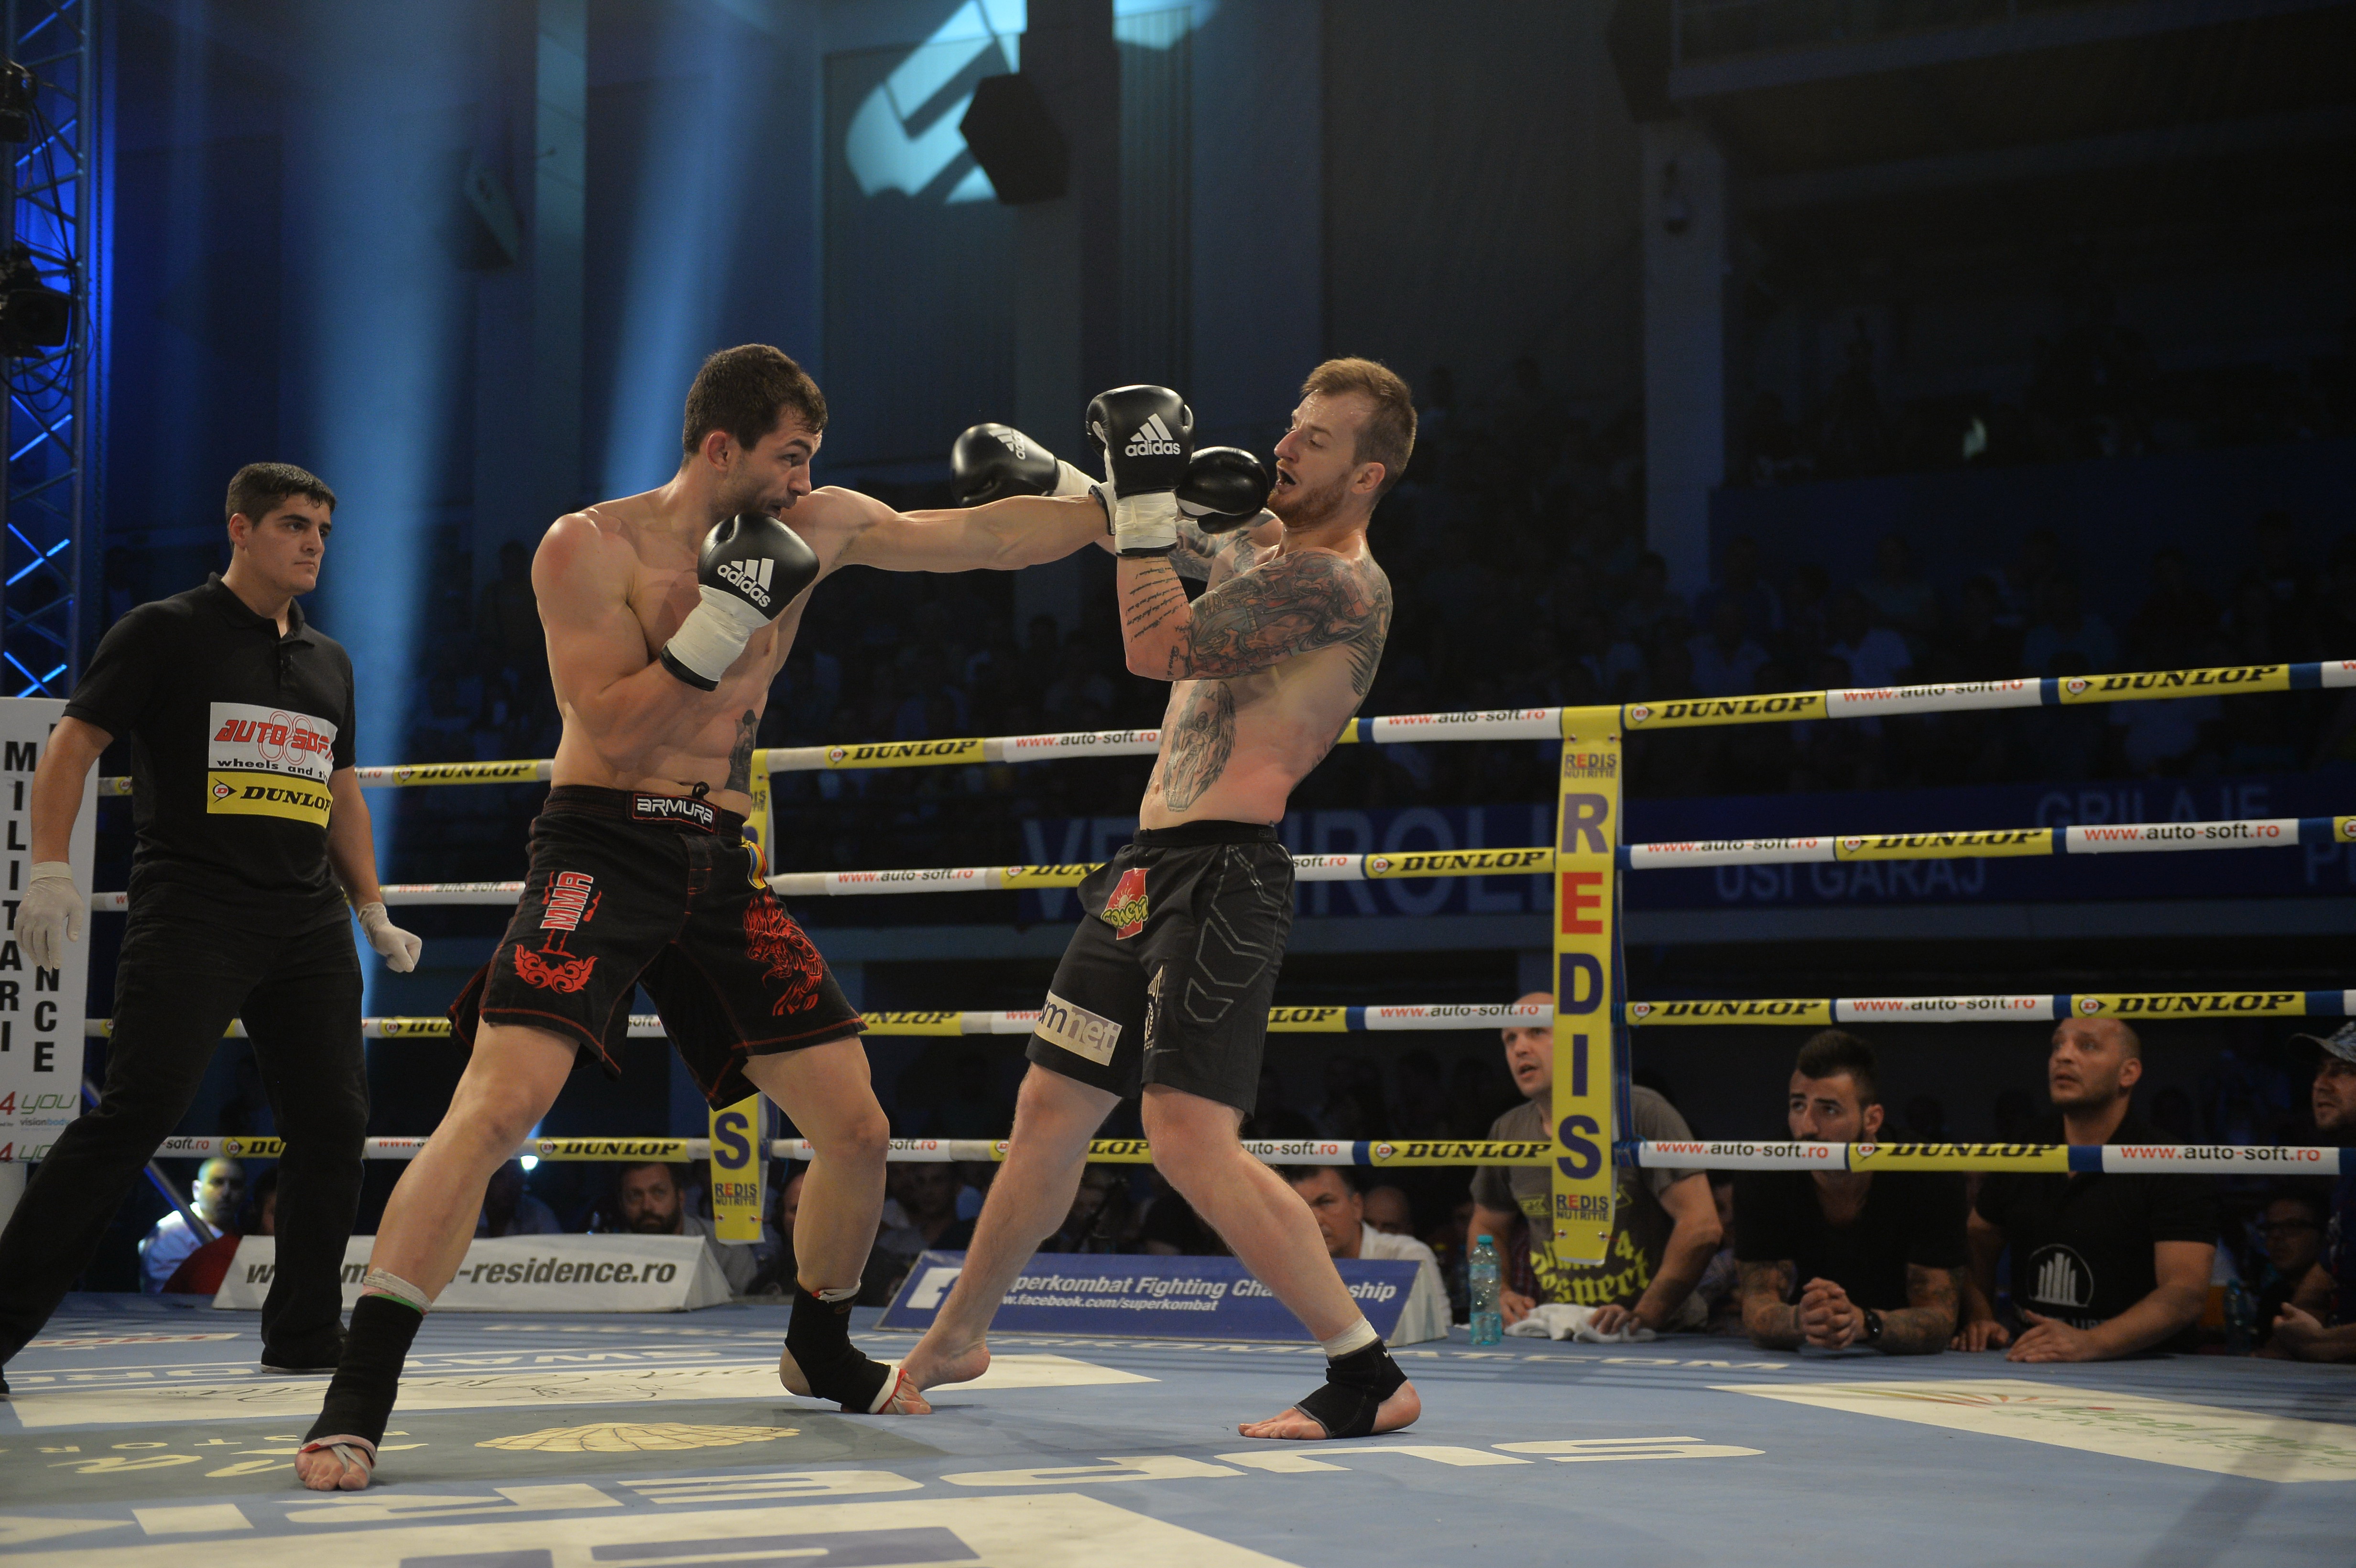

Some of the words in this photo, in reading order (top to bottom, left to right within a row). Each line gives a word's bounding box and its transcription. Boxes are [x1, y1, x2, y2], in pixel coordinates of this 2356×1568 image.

[1125, 438, 1181, 457] adidas
[717, 564, 771, 608] adidas
[2100, 666, 2279, 691] DUNLOP
[1661, 696, 1817, 719] DUNLOP
[1388, 709, 1546, 726] www.auto-soft.ro
[214, 719, 288, 746] AUTO
[1016, 730, 1157, 748] www.auto-soft.ro
[852, 741, 978, 760] DUNLOP
[217, 758, 279, 770] wheels
[288, 765, 313, 775] and
[1565, 753, 1617, 768] REDIS
[419, 764, 531, 779] DUNLOP
[240, 786, 331, 812] DUNLOP
[1873, 831, 2043, 849] DUNLOP
[2085, 823, 2280, 841] www.auto-soft.ro
[1401, 851, 1546, 871] DUNLOP
[839, 869, 973, 884] www.auto-soft.ro
[540, 871, 594, 931] MMA
[1557, 793, 1609, 1180] REDIS
[1380, 1004, 1539, 1018] www.auto-soft.ro
[1663, 1002, 1822, 1017] DUNLOP
[2114, 994, 2295, 1013] DUNLOP
[1269, 1008, 1339, 1023] LOP
[562, 1142, 681, 1156] DUNLOP
[1089, 1140, 1150, 1154] LOP
[1404, 1143, 1552, 1159] DUNLOP
[1656, 1141, 1829, 1160] www.auto-soft.ro
[1888, 1143, 2062, 1157] DUNLOP
[2120, 1144, 2321, 1162] www.auto-soft.ro
[714, 1183, 757, 1196] REDIS
[1556, 1194, 1609, 1211] REDIS
[1556, 1210, 1610, 1222] NUTRITIE
[1011, 1274, 1133, 1293] perkombat
[1135, 1277, 1228, 1298] Fighting
[1232, 1279, 1397, 1303] Chaship
